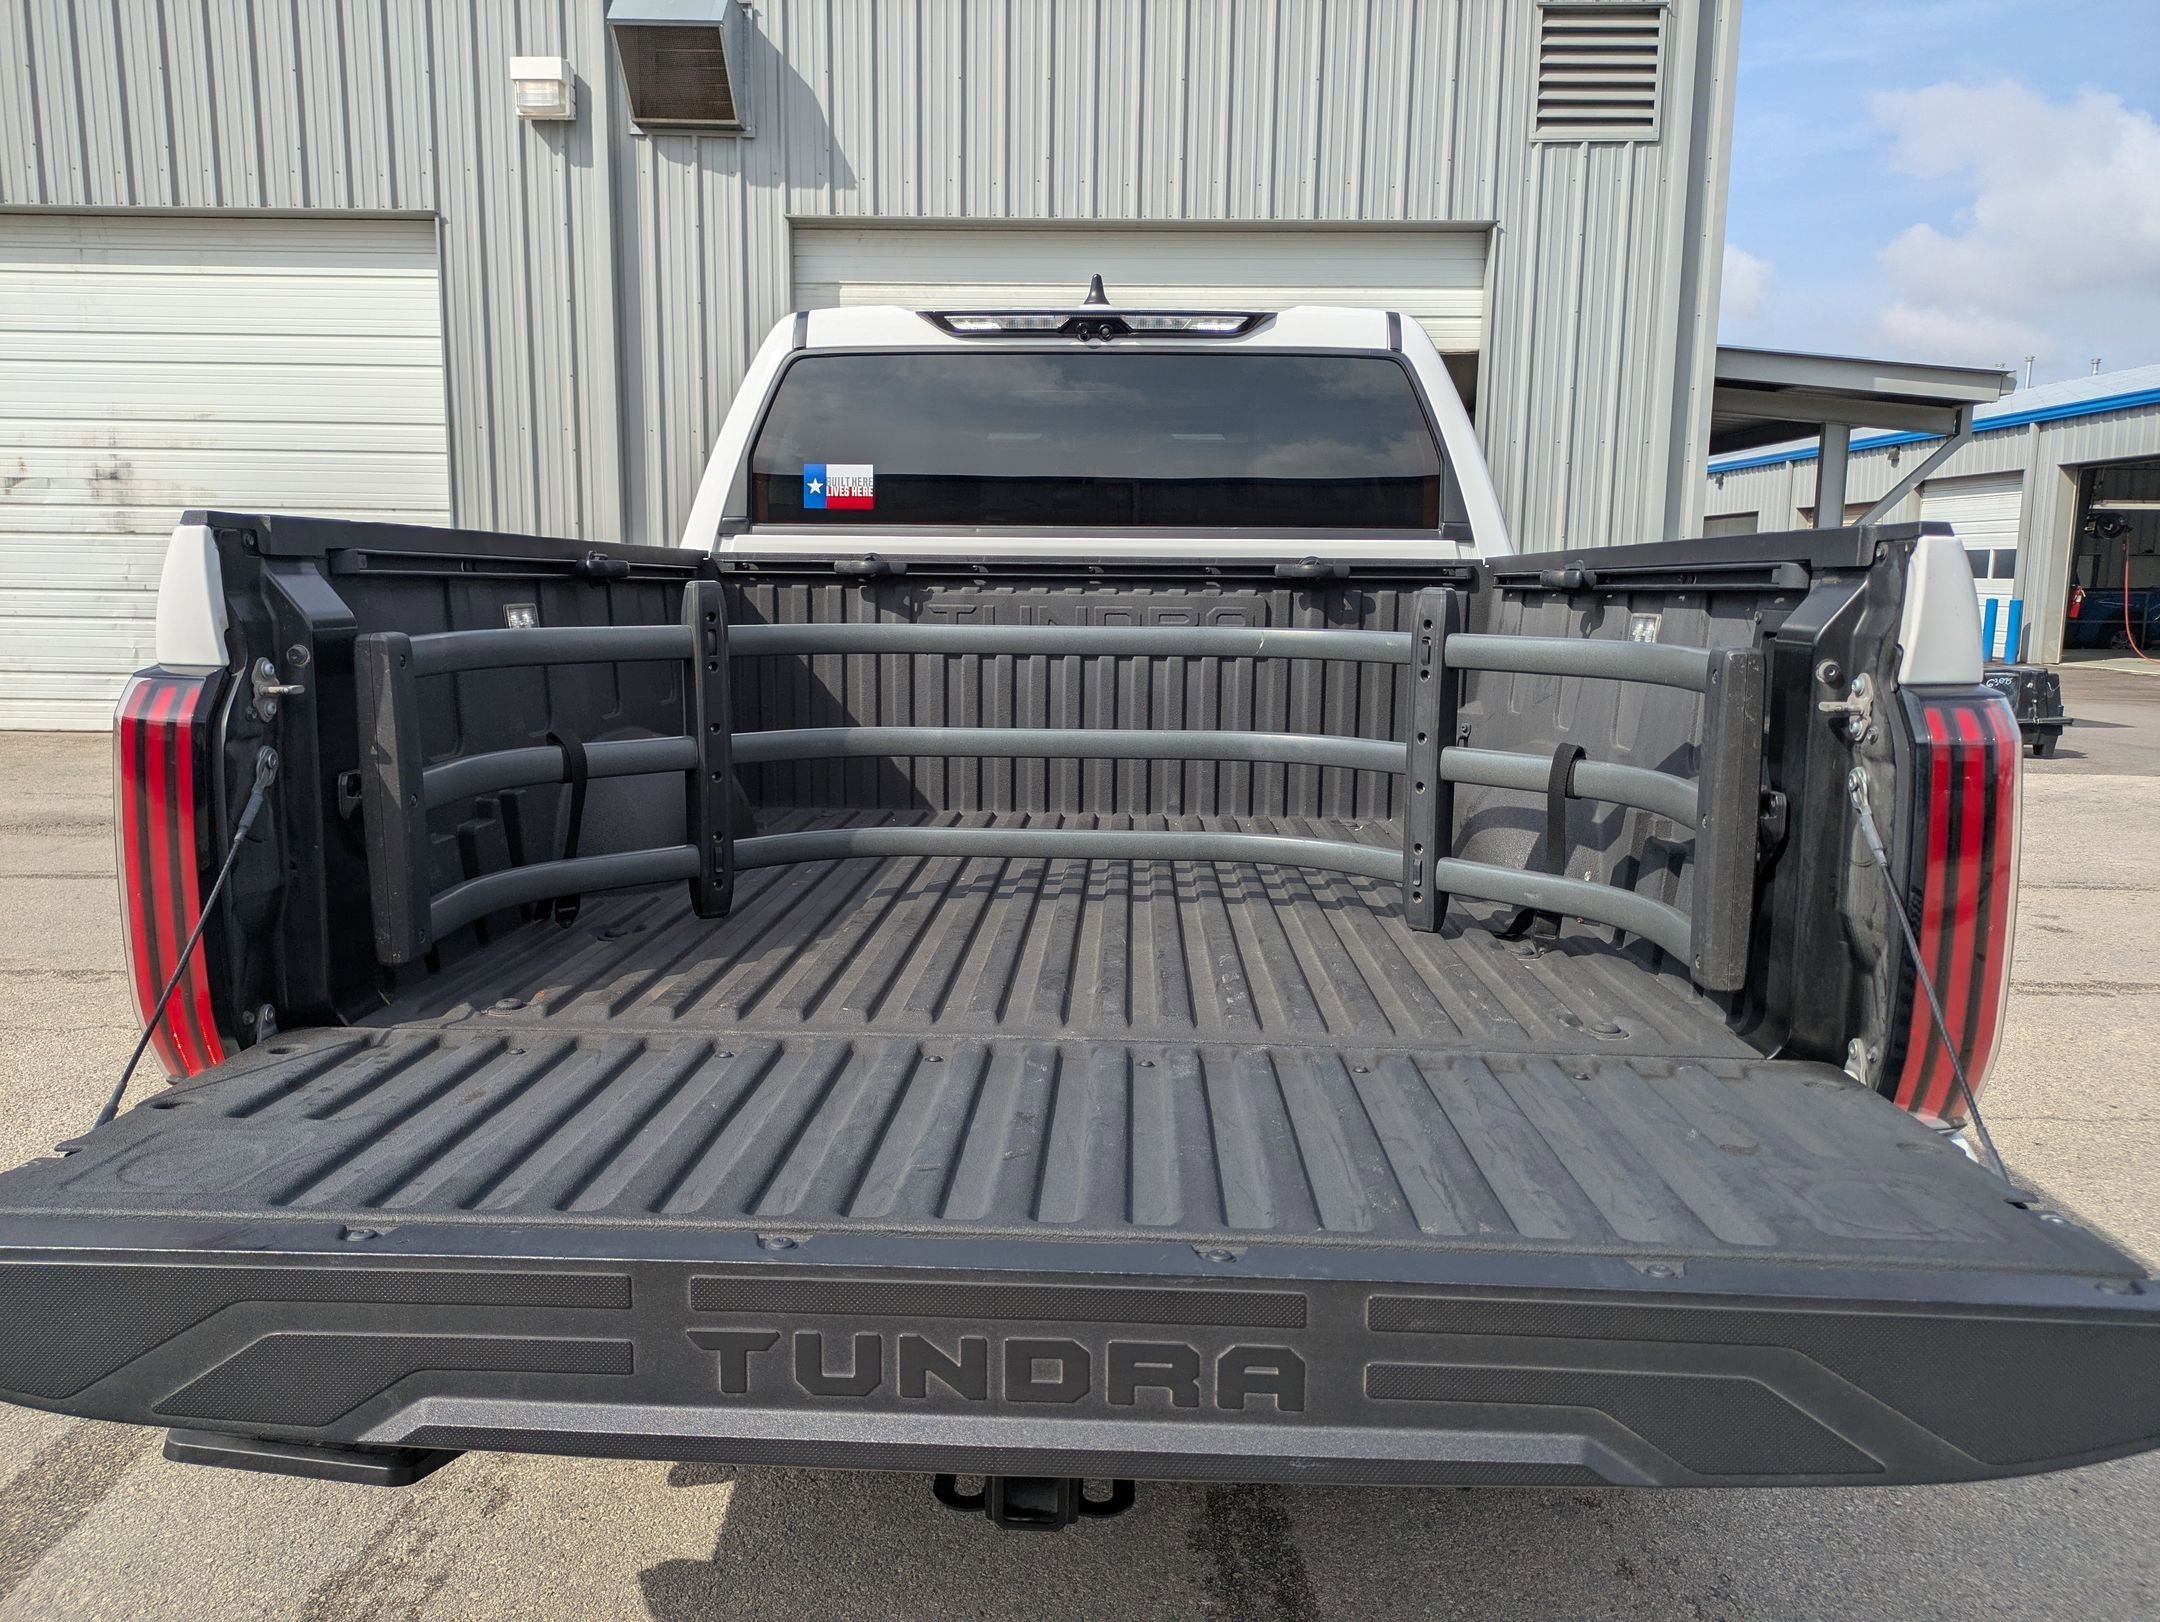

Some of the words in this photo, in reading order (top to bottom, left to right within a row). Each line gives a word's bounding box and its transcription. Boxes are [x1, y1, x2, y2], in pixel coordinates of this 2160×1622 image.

[826, 476, 850, 487] BUILT
[851, 476, 873, 487] HERE
[826, 486, 850, 497] LIVES
[851, 486, 873, 497] HERE
[687, 1329, 1306, 1412] TUNDRA
